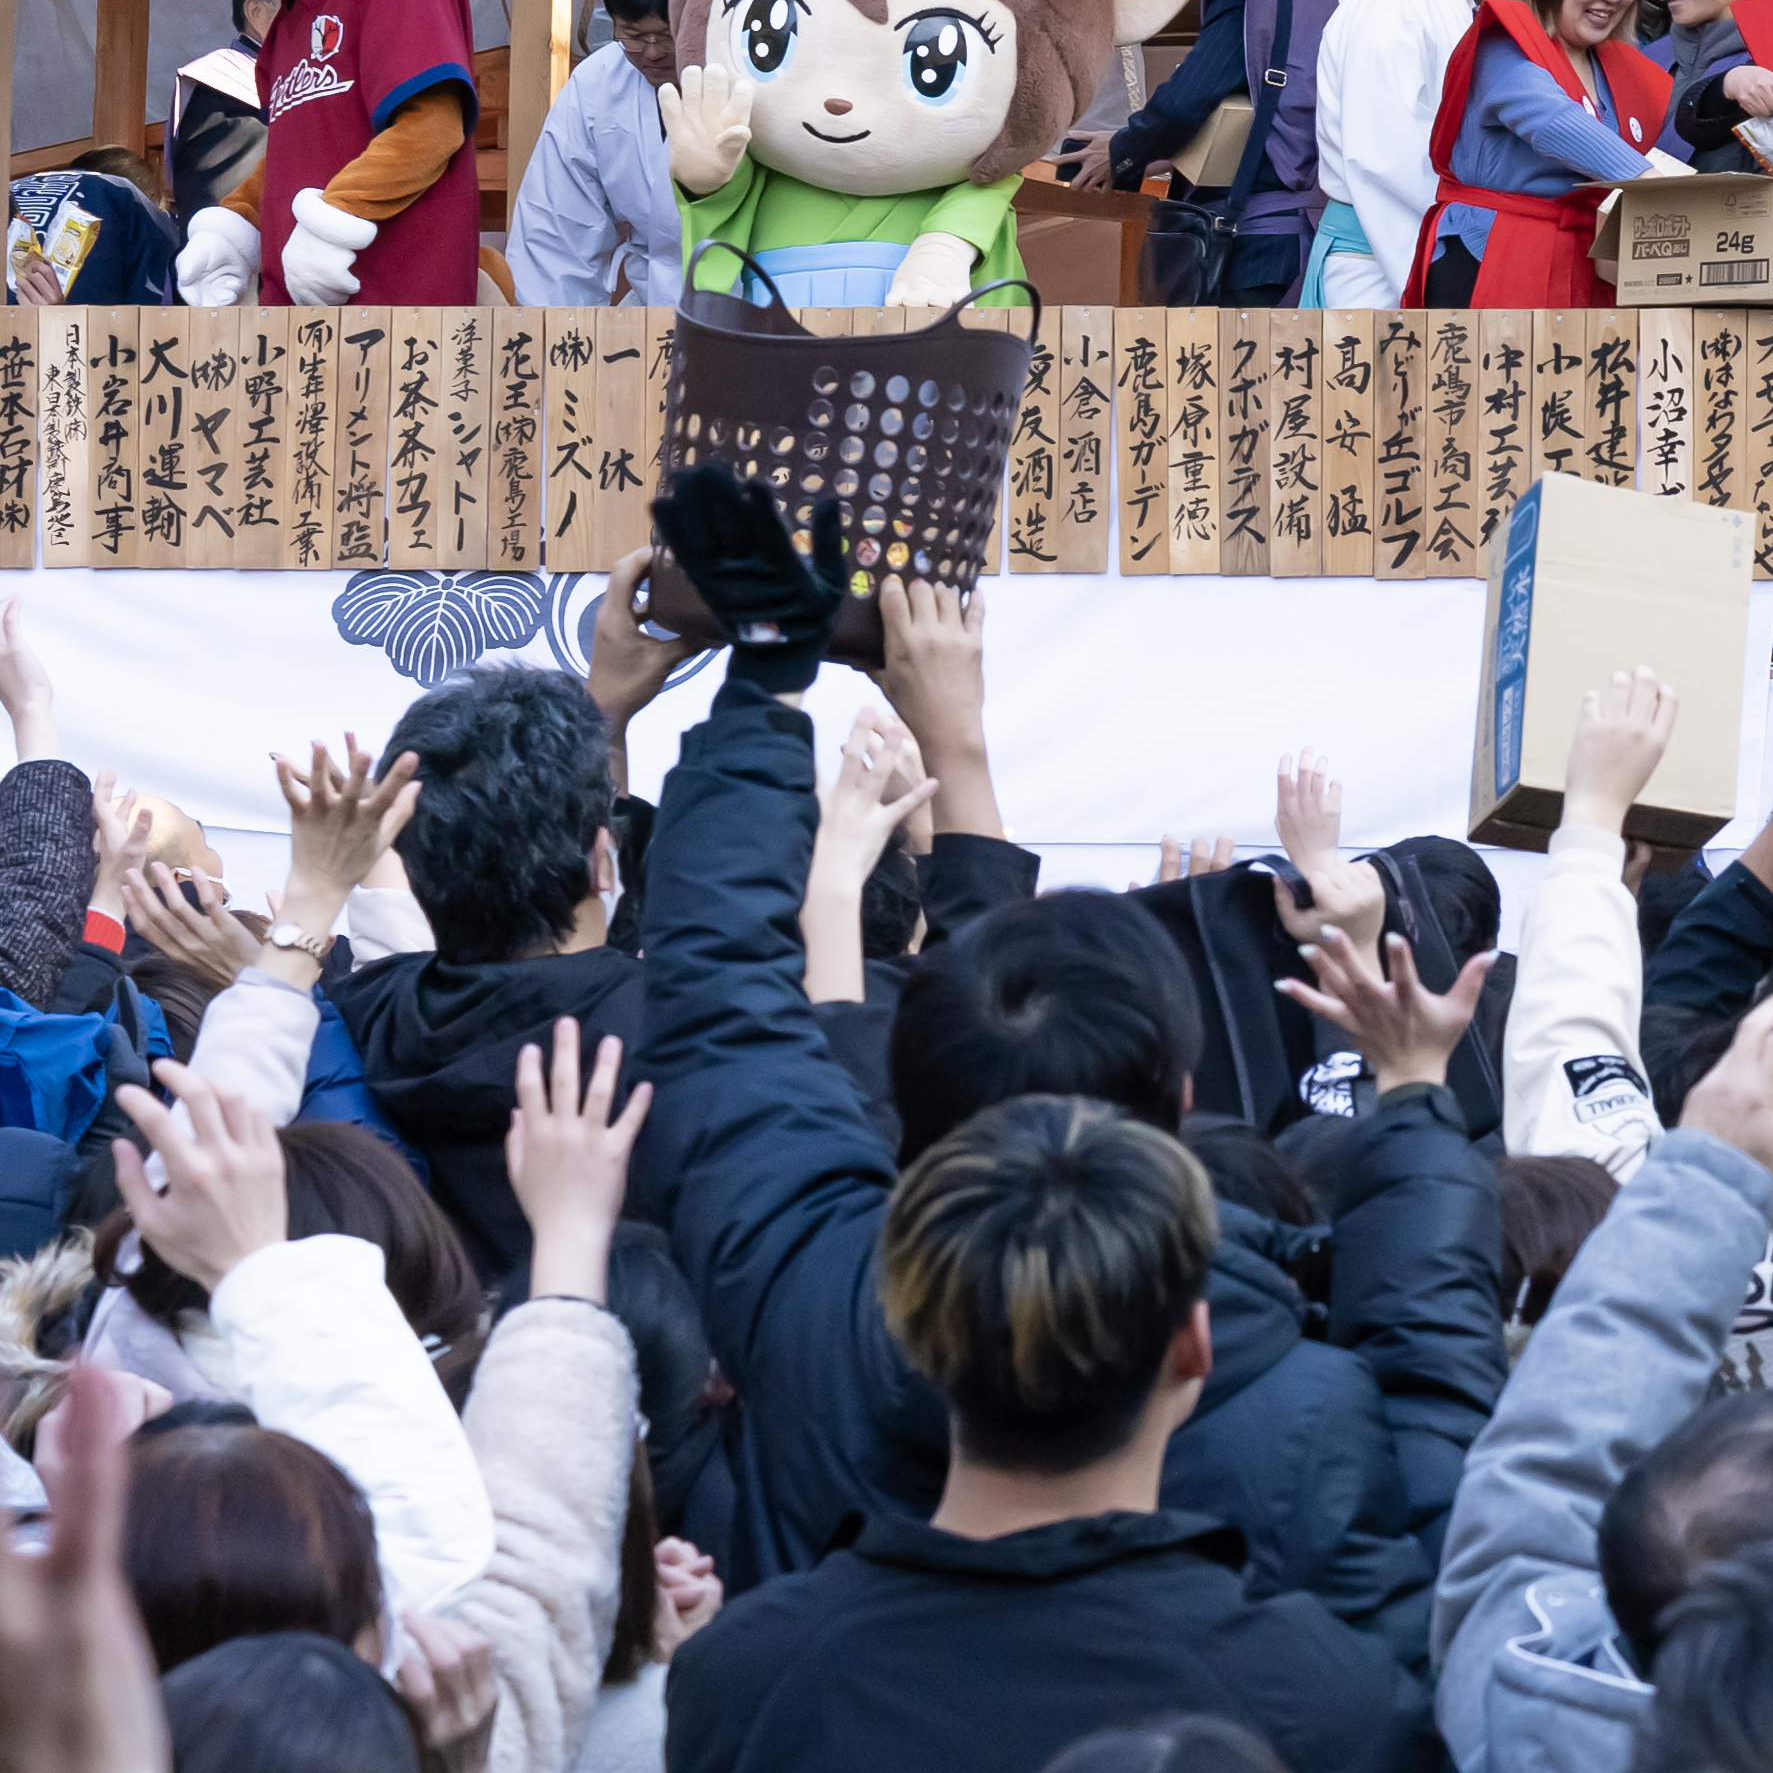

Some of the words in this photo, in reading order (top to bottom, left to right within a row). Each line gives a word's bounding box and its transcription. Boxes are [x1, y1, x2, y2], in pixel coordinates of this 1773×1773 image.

[1716, 229, 1756, 255] 24g
[89, 334, 137, 555] 小岩井商事
[141, 336, 190, 548] 大川運輸
[239, 334, 287, 527] 小野工芸社
[336, 328, 385, 563] アリメント将監
[599, 347, 645, 493] 一休
[1062, 334, 1111, 525] 小倉酒店
[1118, 337, 1167, 562] 鹿島ガーデン
[1169, 341, 1218, 542] 塚原重徳
[1223, 339, 1271, 545] クボガラス
[1273, 337, 1320, 549] 村屋設備
[1378, 321, 1422, 570] みどりが丘ゴルフ
[1586, 336, 1637, 490] 松井建
[1645, 338, 1688, 497] 小沼幸
